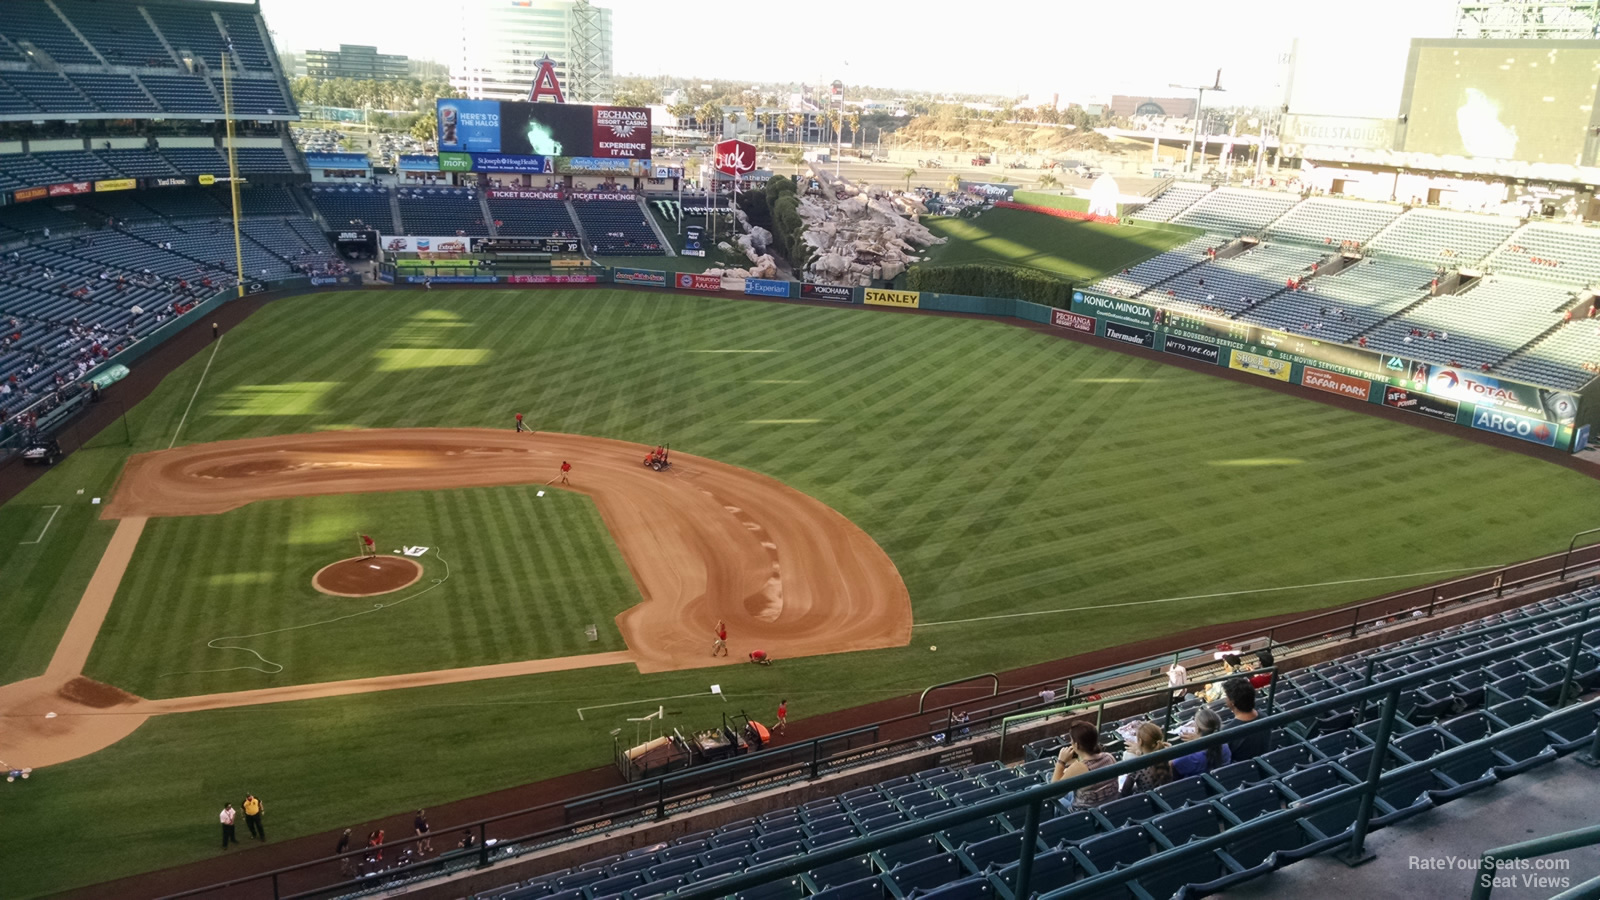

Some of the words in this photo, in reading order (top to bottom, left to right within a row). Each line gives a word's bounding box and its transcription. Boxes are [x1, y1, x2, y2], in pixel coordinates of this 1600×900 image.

[460, 112, 486, 120] HERE'S
[597, 110, 647, 120] PECHANGA
[1295, 124, 1329, 138] ANGEL
[1333, 127, 1386, 142] STADIUM
[599, 141, 646, 150] EXPERIENCE
[311, 276, 337, 286] Corona
[755, 284, 785, 293] Experian
[814, 286, 850, 295] YOKOHAMA
[866, 292, 918, 304] STANLEY
[1084, 295, 1114, 309] KONICA
[1115, 302, 1151, 317] MINOLTA
[1056, 312, 1091, 327] PECHANGA
[1107, 328, 1144, 344] Thermador
[1183, 330, 1216, 343] HOUSEHOLD
[1216, 338, 1244, 350] SERVICES
[1166, 340, 1185, 350] NITTO
[1187, 346, 1217, 358] TIRE.COM
[1236, 353, 1263, 365] SHOCK
[1269, 360, 1285, 370] TOP
[1280, 353, 1317, 366] SELF-MOVING
[1319, 361, 1345, 373] SERVICES
[1347, 368, 1362, 376] THAT
[1305, 376, 1338, 390] SAFARI
[1340, 384, 1366, 397] PARK
[1464, 379, 1518, 402] TOTAL
[1397, 399, 1418, 408] POWER
[1528, 406, 1542, 414] OILS
[1478, 412, 1530, 436] ARCO
